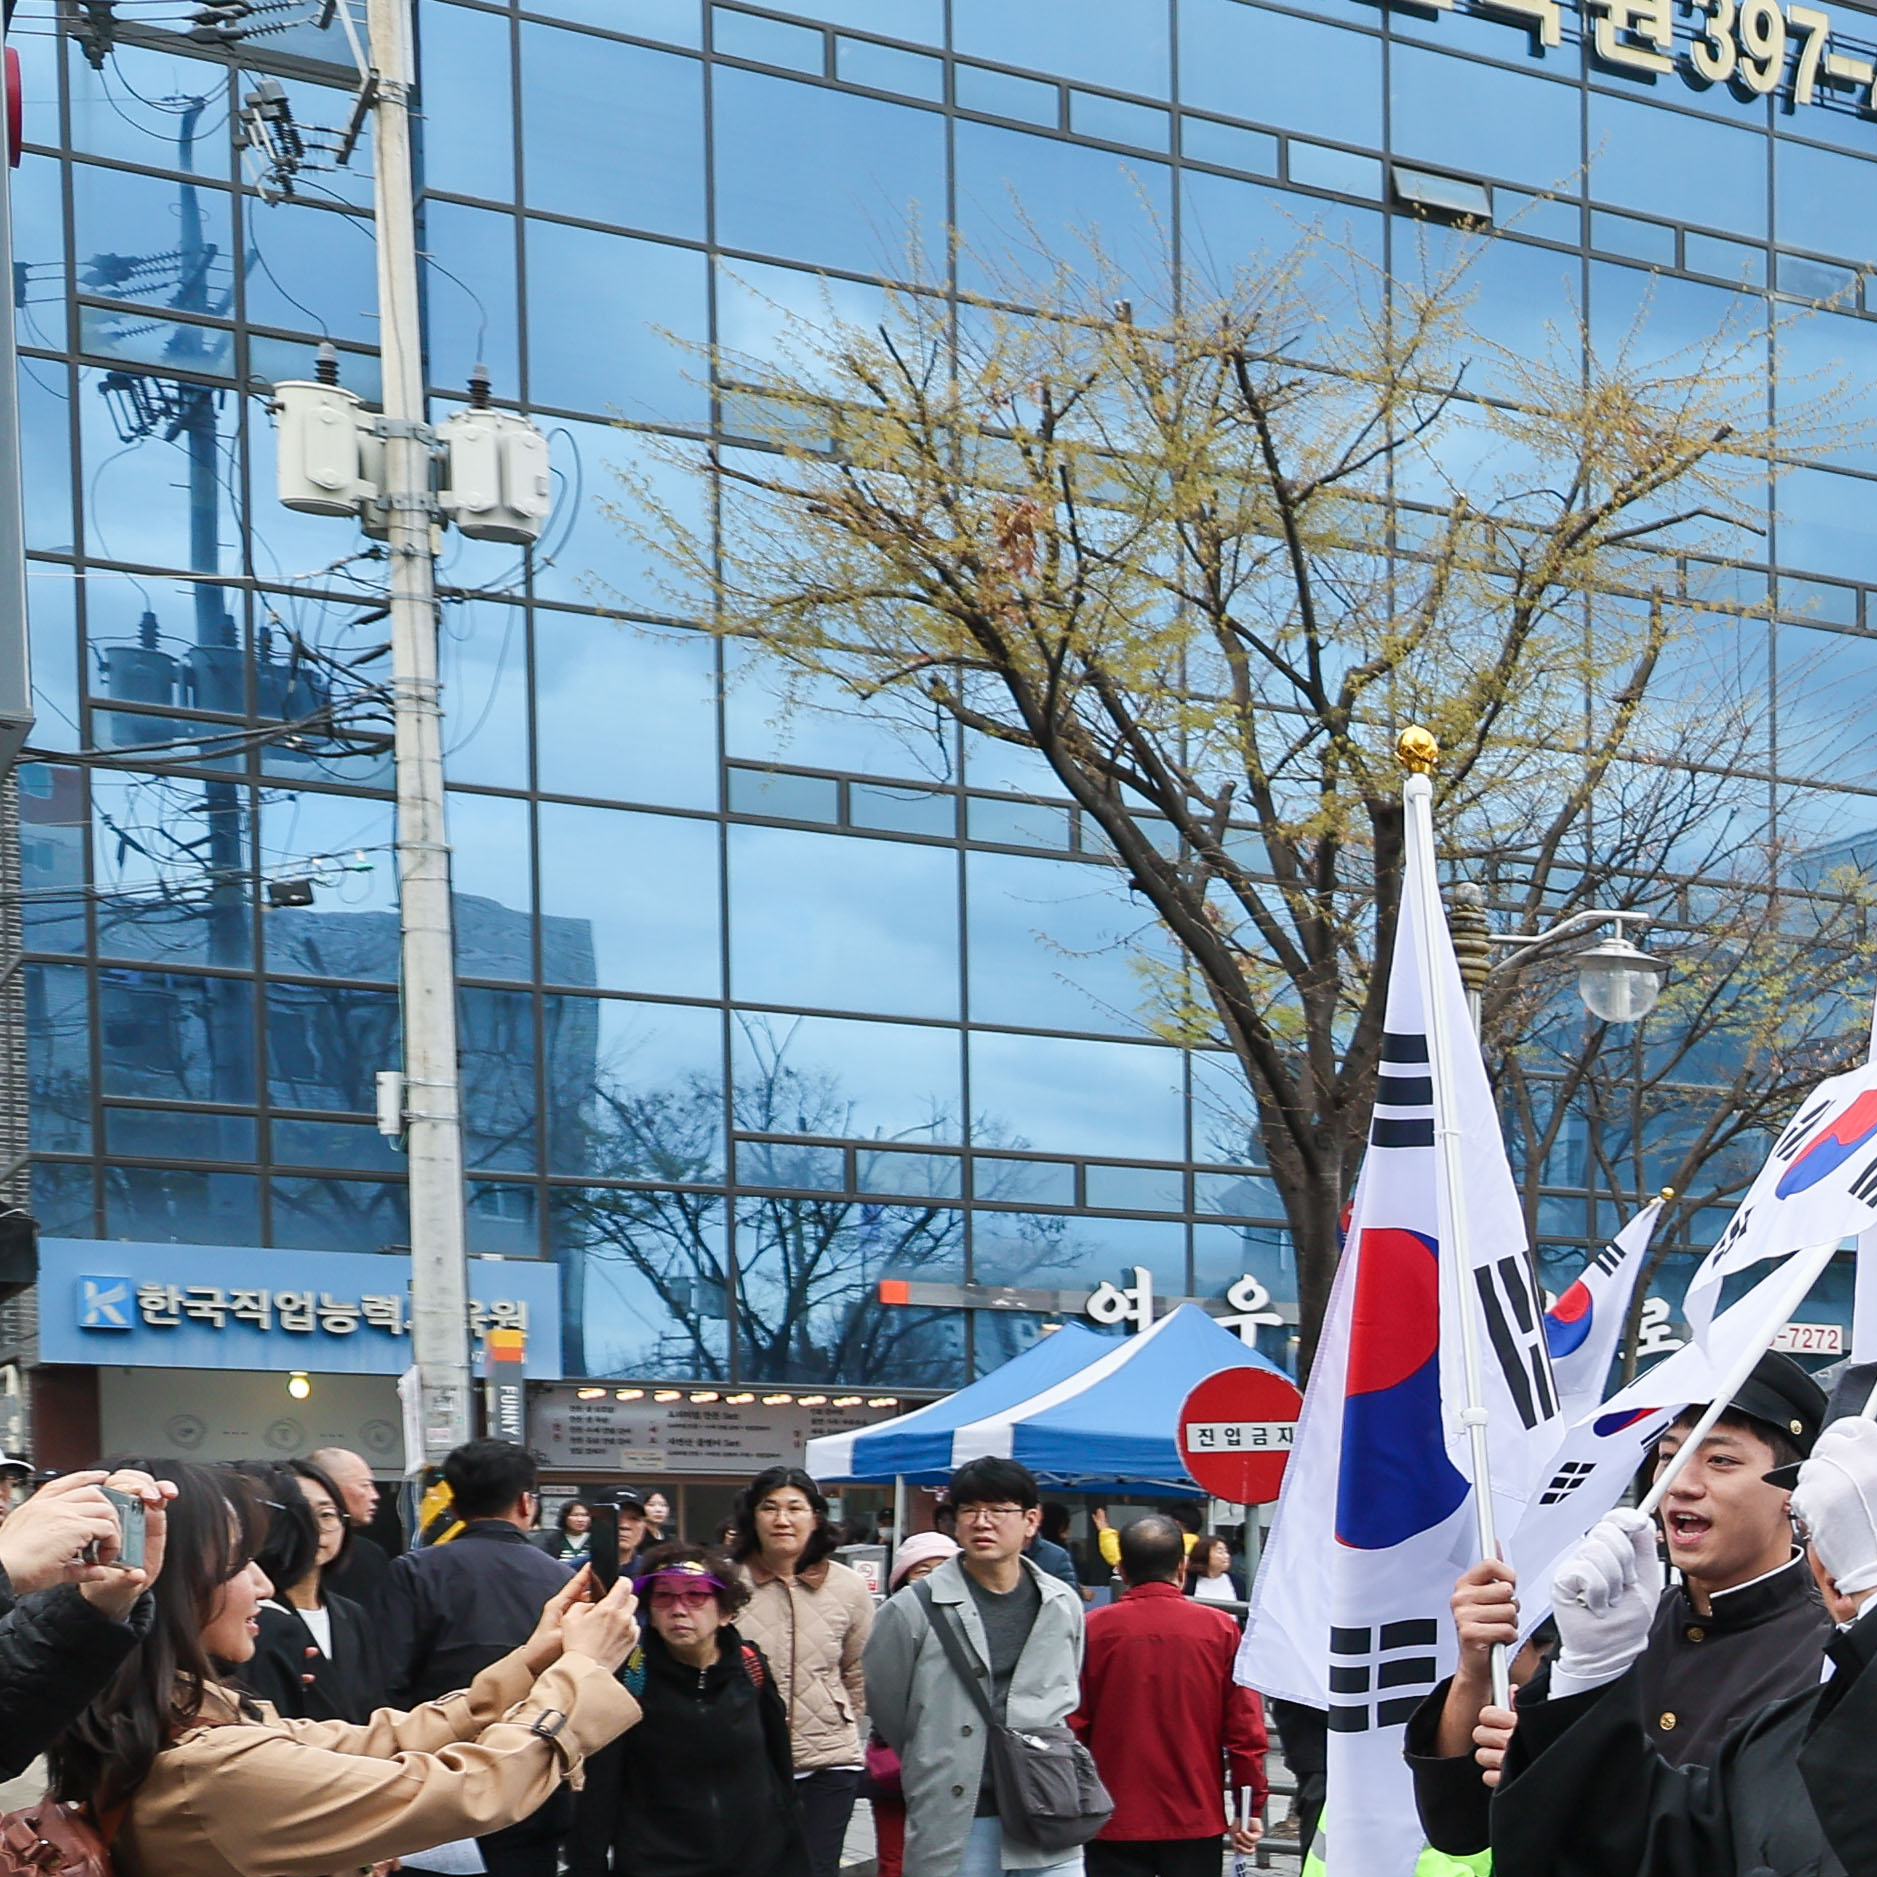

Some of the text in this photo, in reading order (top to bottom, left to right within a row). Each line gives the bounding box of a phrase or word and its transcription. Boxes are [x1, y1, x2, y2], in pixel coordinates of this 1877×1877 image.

[136, 1284, 528, 1340] 한국직업능력원
[500, 1385, 520, 1436] FUNNY
[1197, 1426, 1294, 1447] 진입금지
